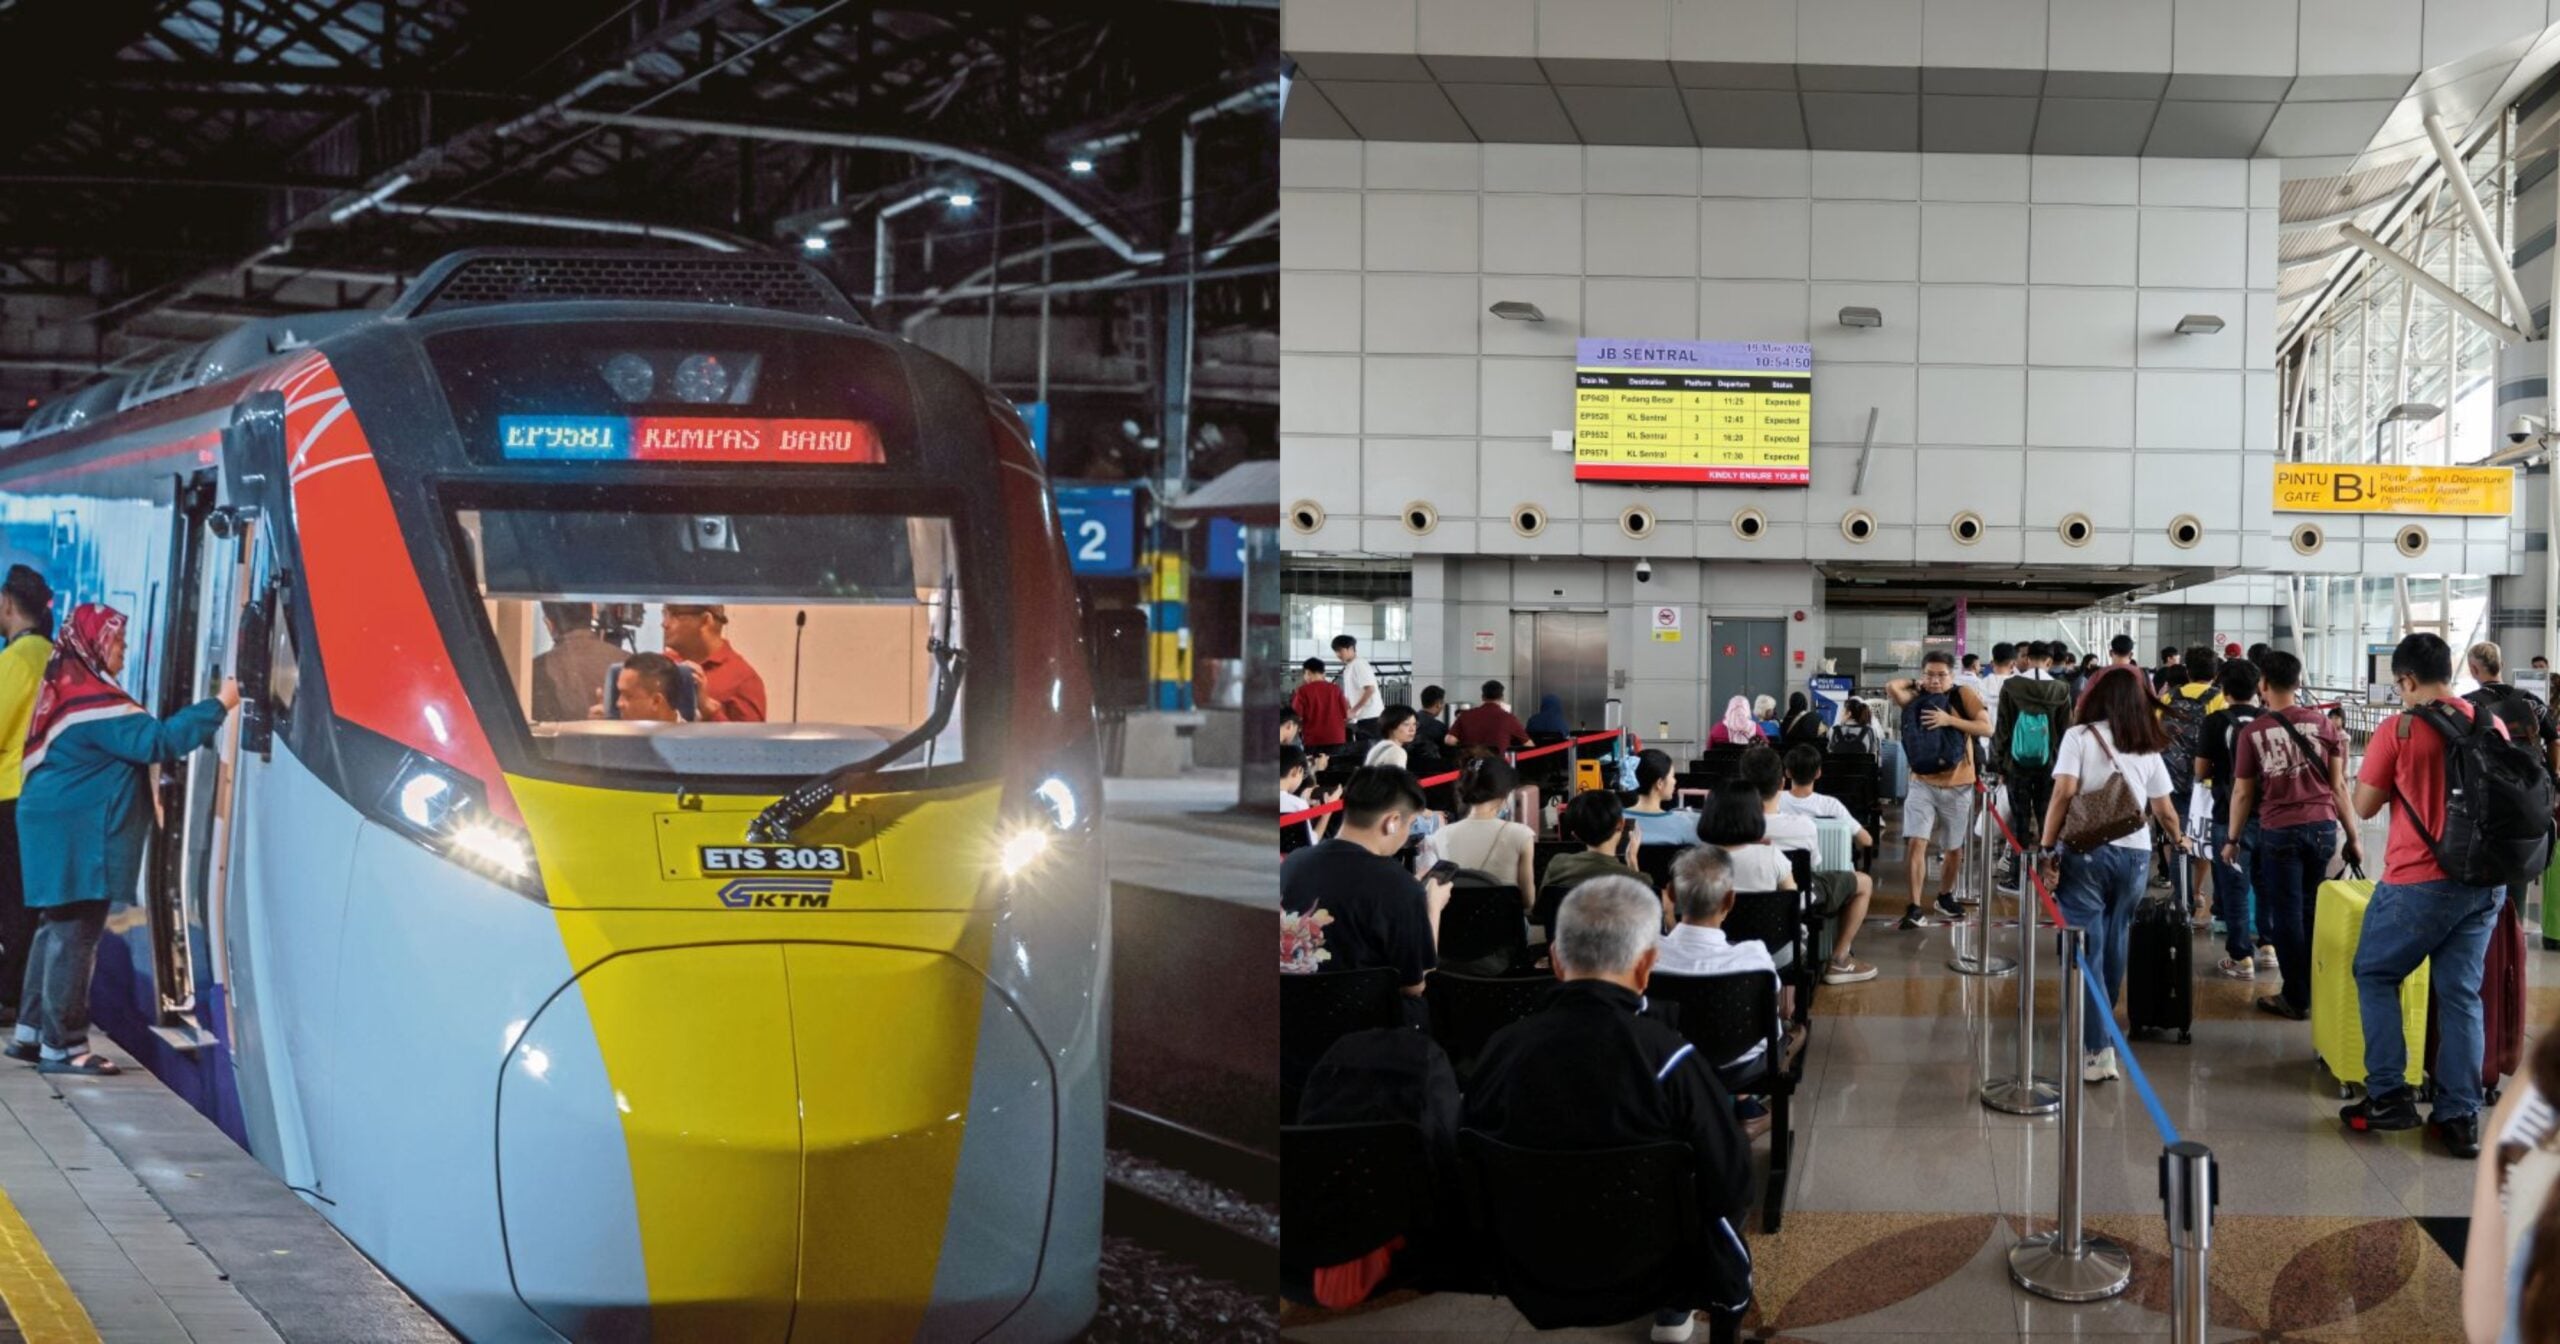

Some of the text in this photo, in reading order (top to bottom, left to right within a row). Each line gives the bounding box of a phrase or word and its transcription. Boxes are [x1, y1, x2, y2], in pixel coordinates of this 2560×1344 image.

[1597, 347, 1698, 362] JB SENTRAL
[1755, 357, 1810, 369] 10:54:50
[1580, 377, 1598, 385] Train
[1628, 378, 1667, 387] Destination
[1684, 379, 1712, 388] Platform
[1717, 380, 1750, 390] Departure
[1772, 381, 1794, 390] Status
[1621, 394, 1650, 405] Padang
[1765, 397, 1801, 407] Expected
[1627, 413, 1667, 422] KL Sentral
[1764, 416, 1800, 426] Expected
[643, 428, 761, 451] KEMPAS
[779, 429, 853, 452] BARU
[1627, 431, 1667, 441] KL Sentral
[1764, 434, 1800, 444] Expected
[1626, 450, 1667, 459] KL Sentral
[1763, 452, 1799, 462] Expected
[1708, 471, 1738, 480] KINDLY
[1740, 472, 1773, 480] ENSURE
[1775, 472, 1798, 481] YOUR
[2278, 472, 2328, 486] PINTU
[2450, 474, 2505, 485] Departure
[2333, 473, 2363, 503] B
[2284, 491, 2320, 503] GATE
[1078, 520, 1107, 561] 2
[704, 848, 841, 870] ETS 303
[754, 893, 831, 909] KTM
